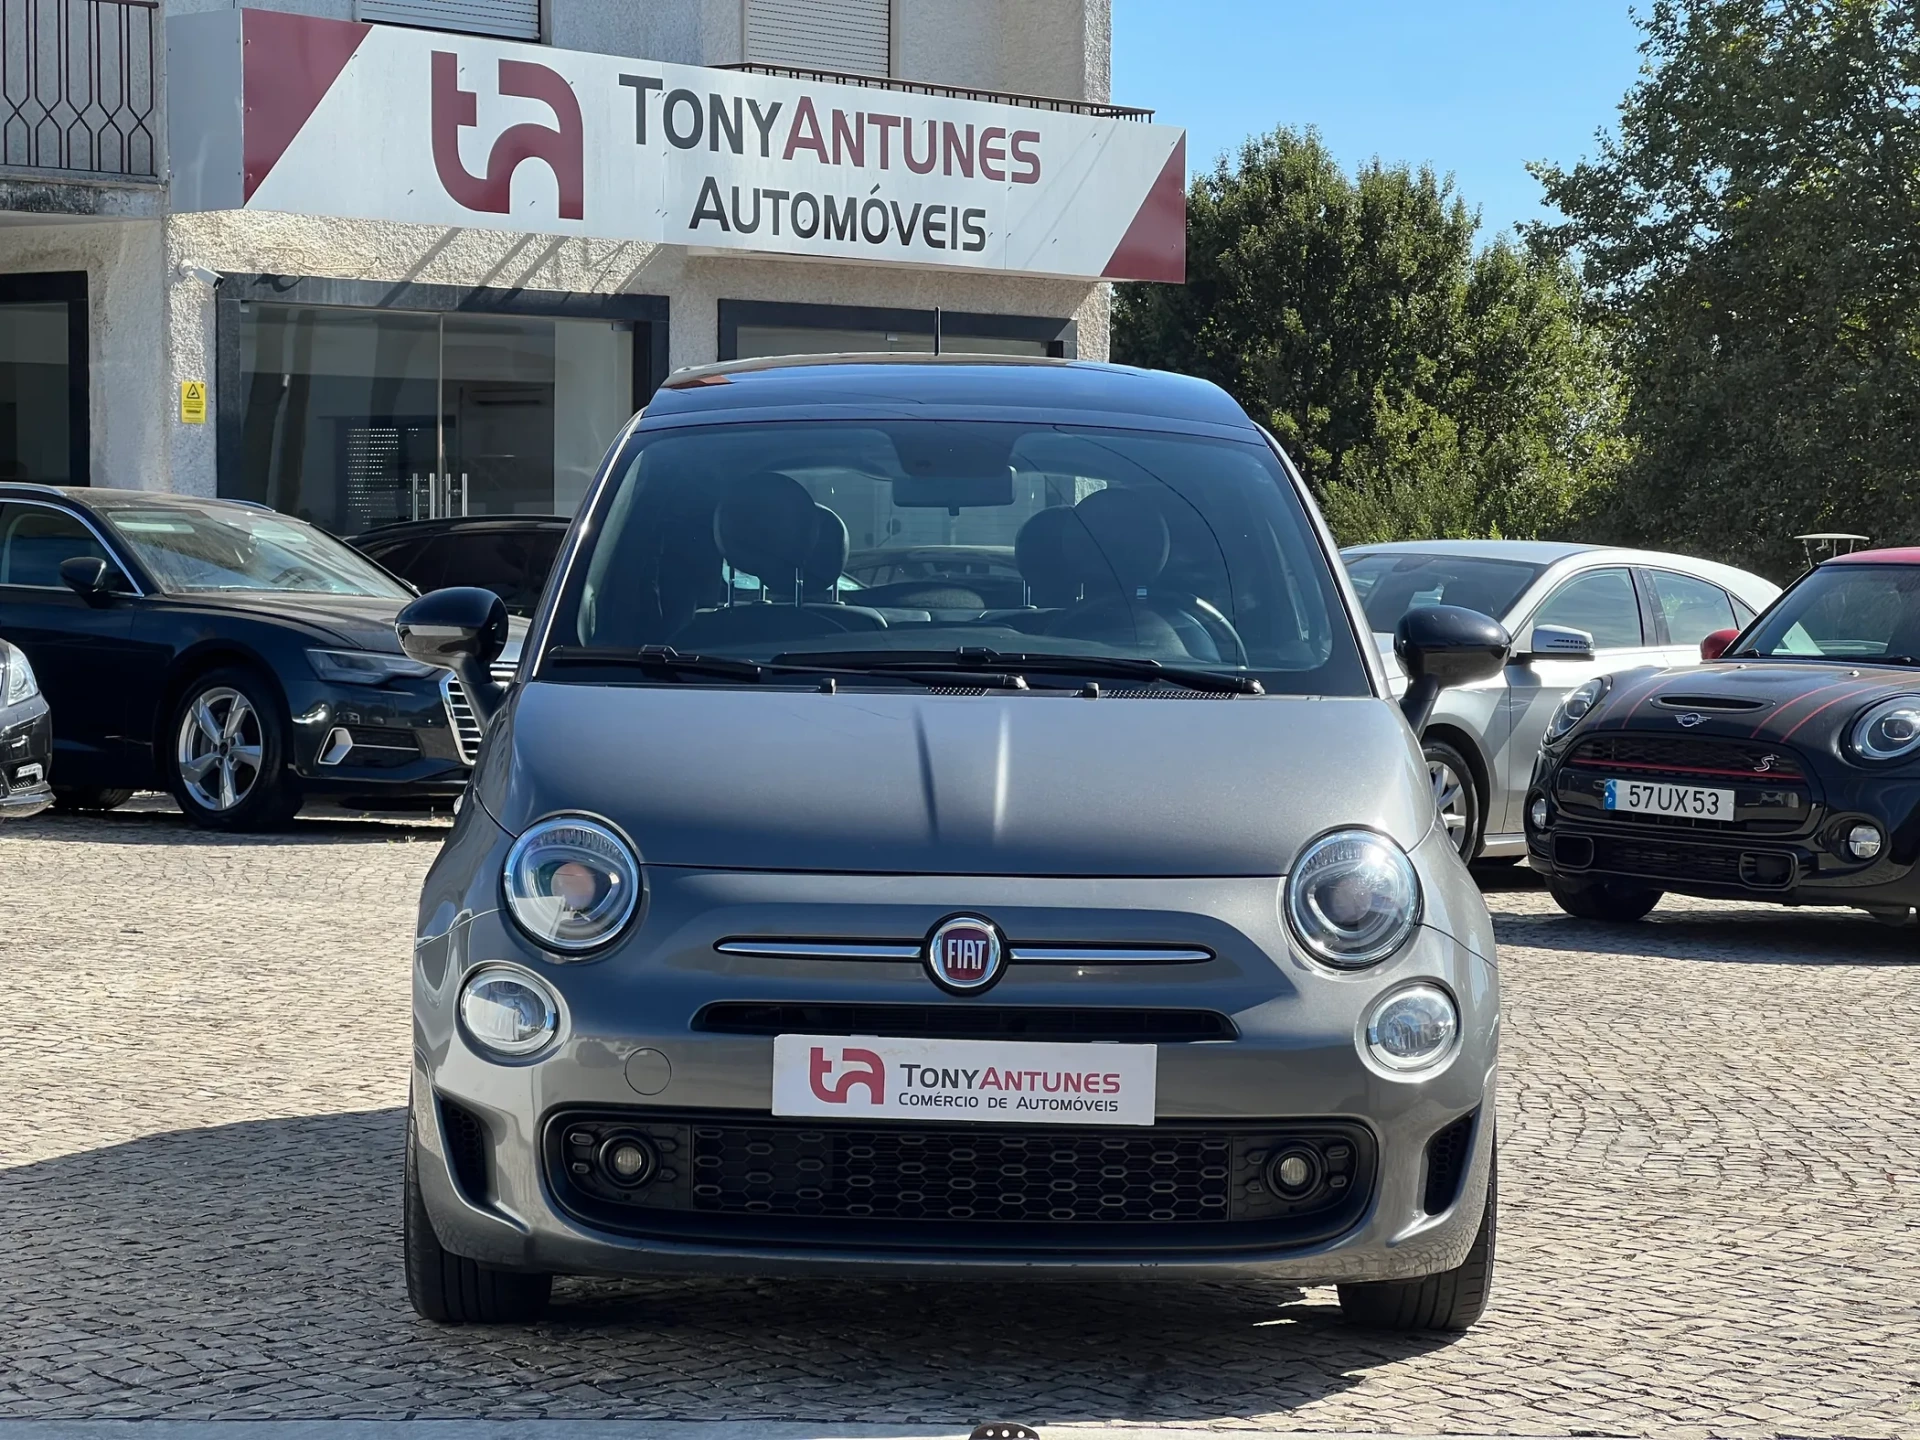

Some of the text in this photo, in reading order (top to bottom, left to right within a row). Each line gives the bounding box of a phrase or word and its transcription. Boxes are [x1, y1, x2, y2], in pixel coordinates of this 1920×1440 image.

[688, 176, 987, 252] AUTOMÓVEIS
[1629, 784, 1719, 815] 57UX53
[947, 939, 987, 970] FIAT
[898, 1091, 1119, 1112] COMÉRCIO DE AUTOMÓVEIS
